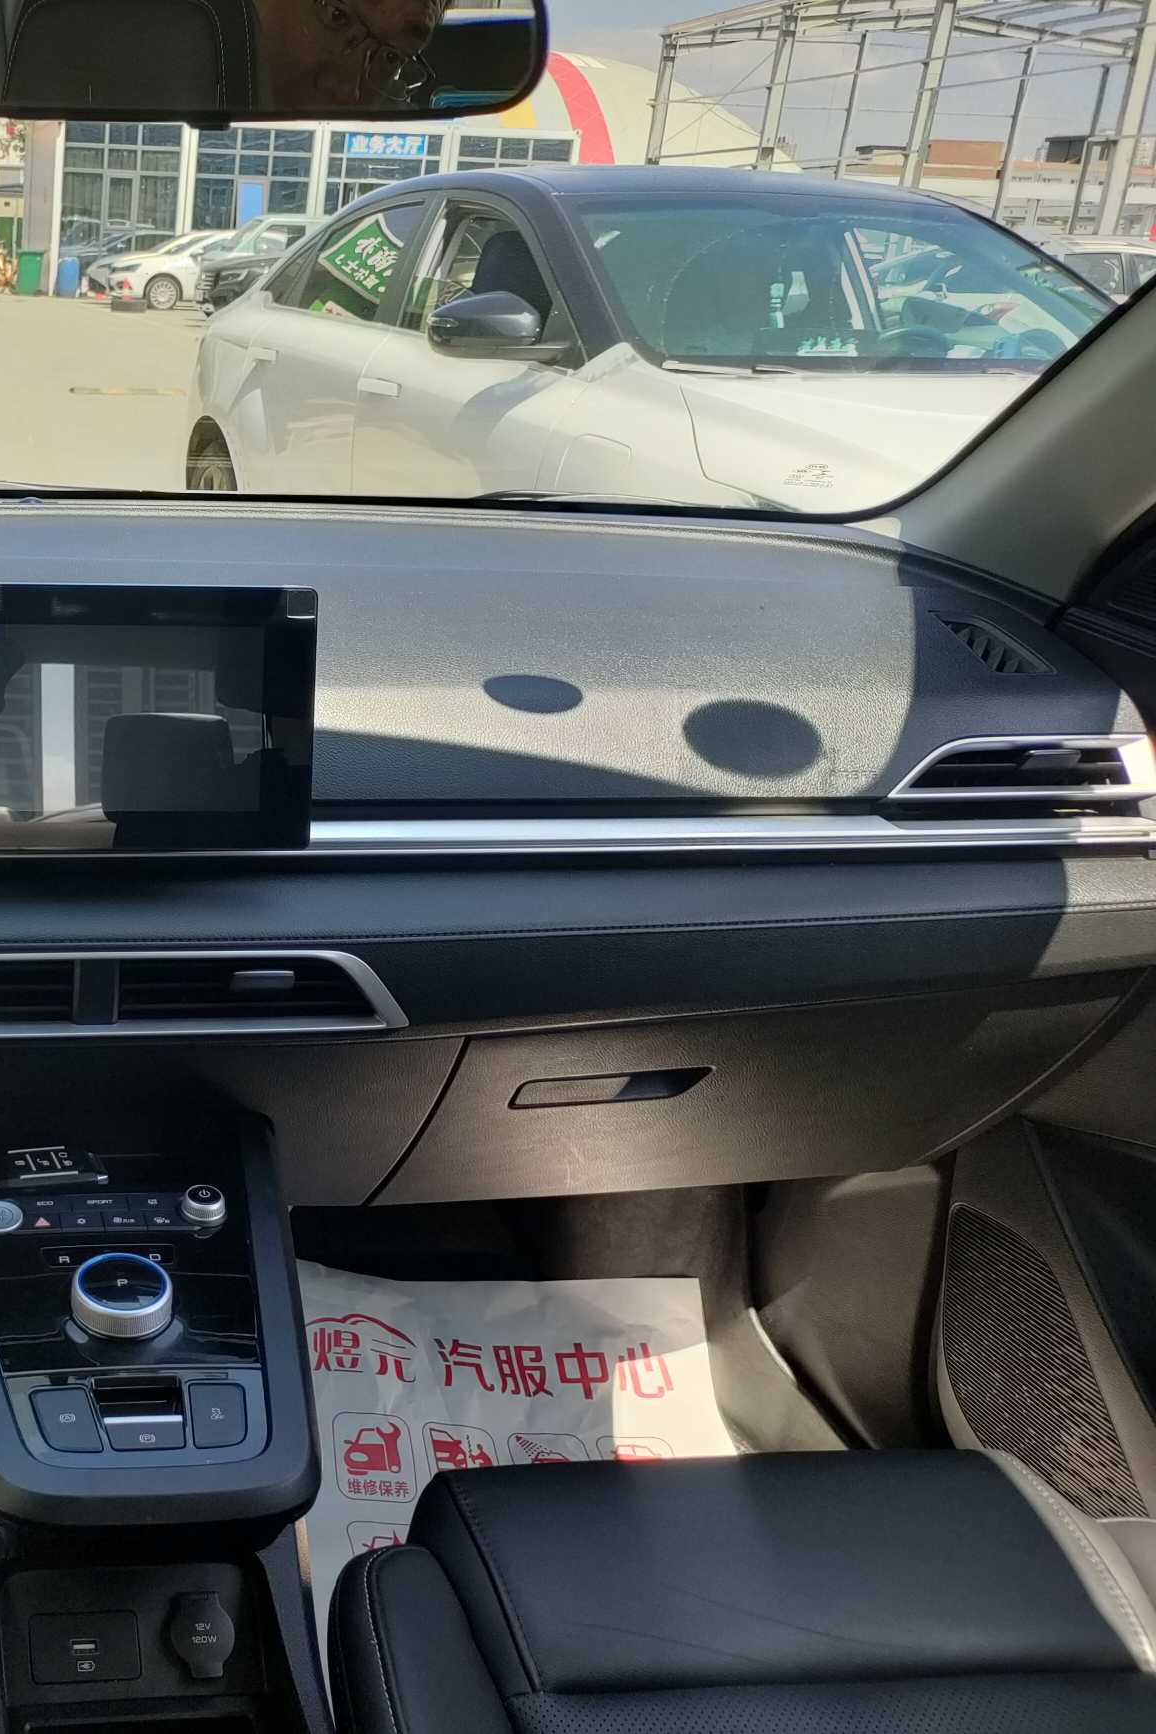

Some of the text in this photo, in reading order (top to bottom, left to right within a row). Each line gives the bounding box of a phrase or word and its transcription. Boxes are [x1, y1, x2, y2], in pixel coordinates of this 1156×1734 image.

[348, 134, 422, 154] 业务大厅
[58, 1255, 71, 1264] R
[116, 1278, 128, 1287] P
[312, 1327, 674, 1400] 煜元 汽服中心
[347, 1479, 410, 1498] 维修保养
[195, 1623, 211, 1631] 12V
